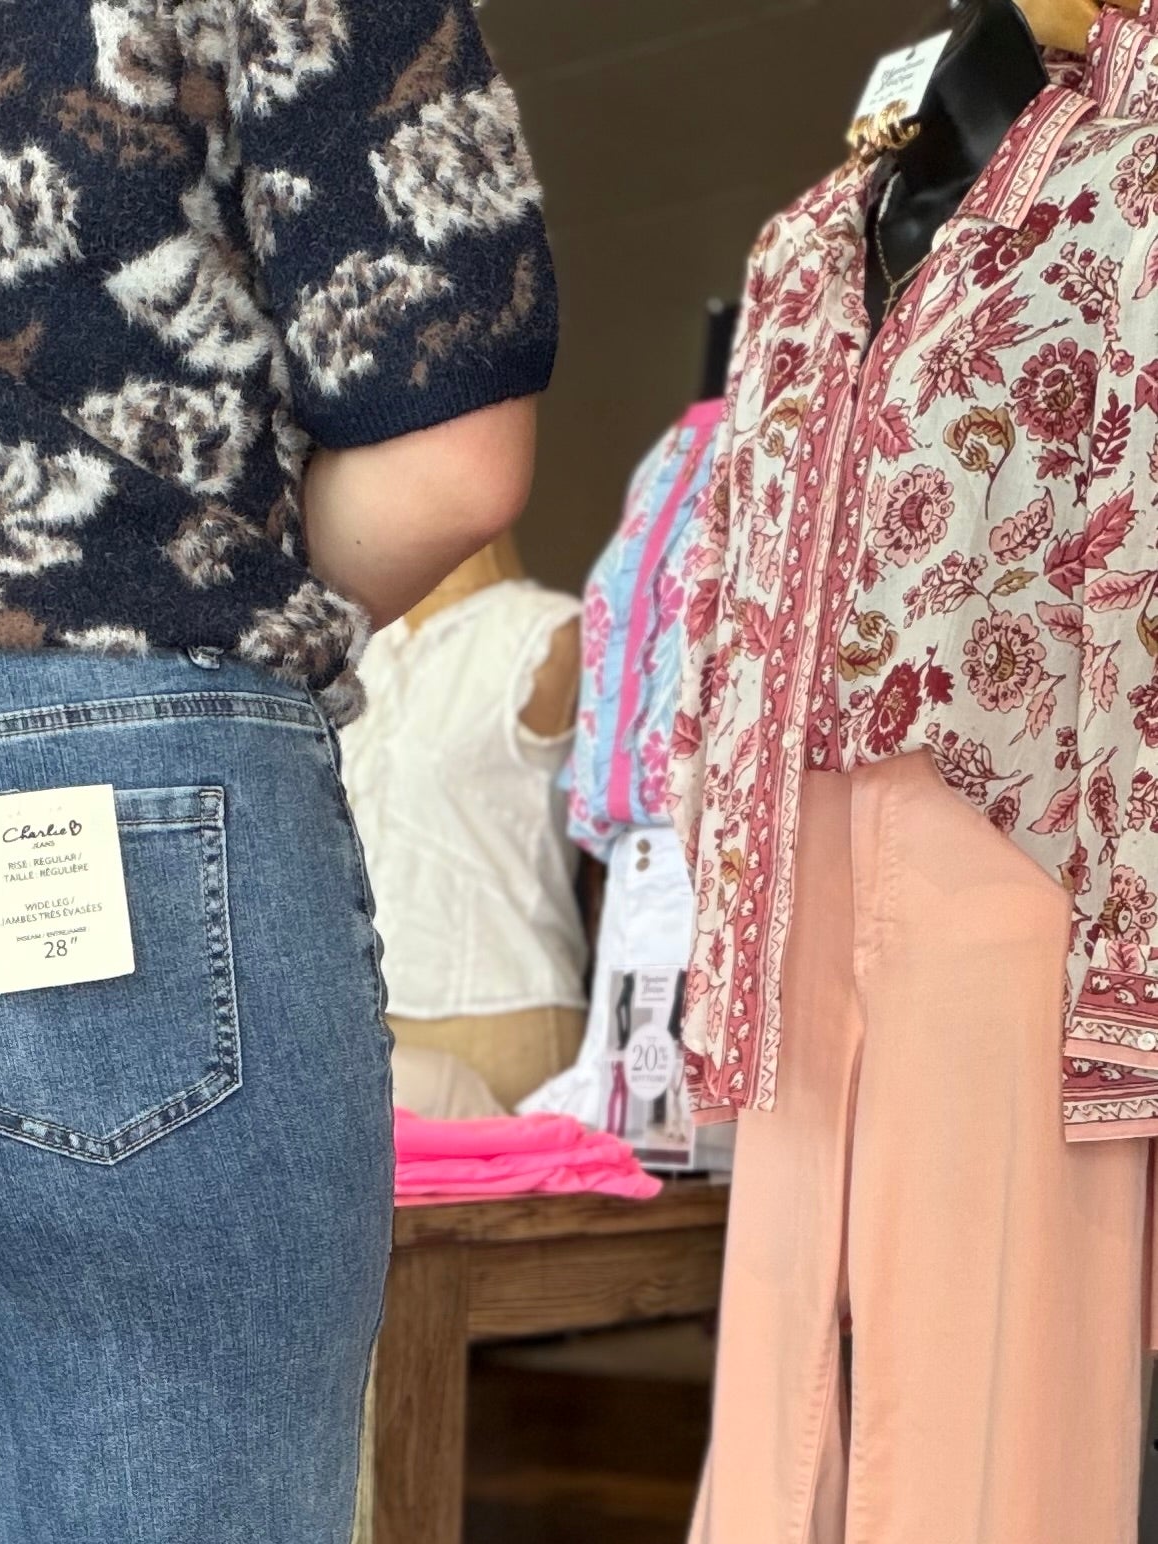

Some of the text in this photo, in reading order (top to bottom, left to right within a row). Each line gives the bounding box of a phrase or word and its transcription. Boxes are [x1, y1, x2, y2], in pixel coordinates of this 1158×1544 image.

[2, 824, 67, 843] Charlie
[34, 853, 76, 866] REGULAR
[25, 900, 50, 911] WIDE
